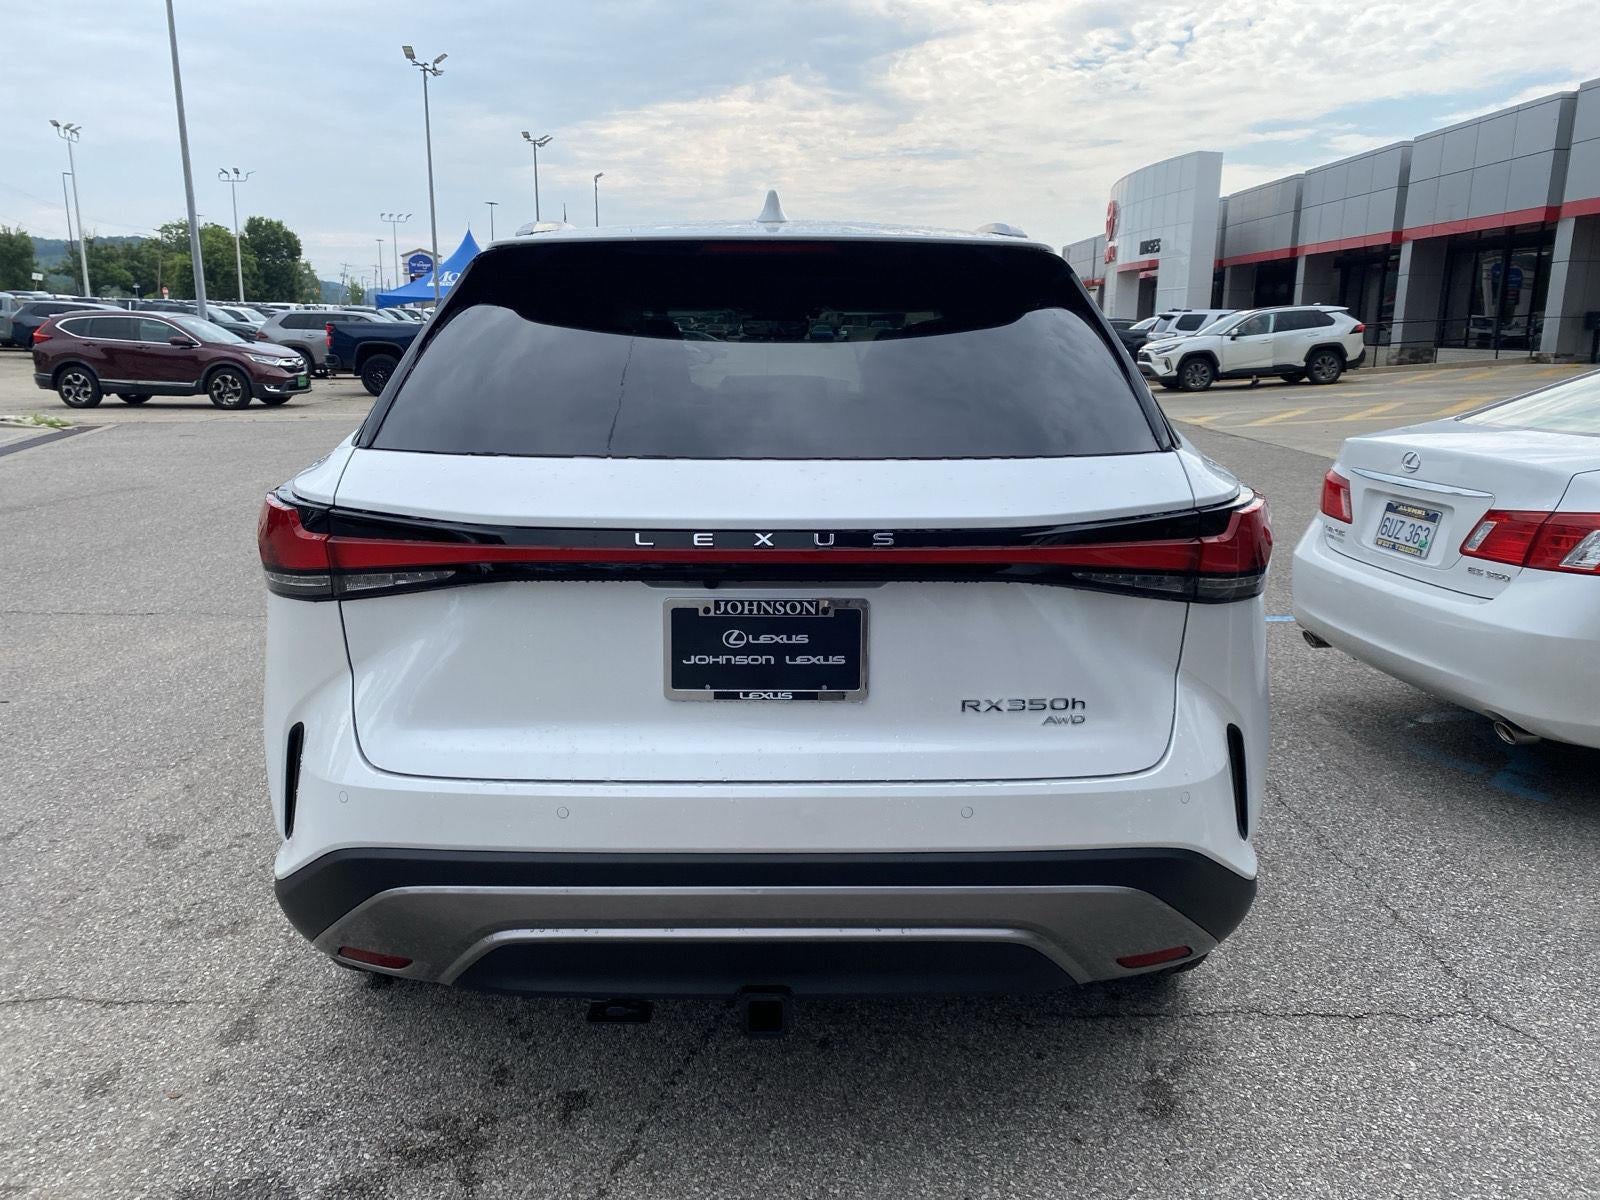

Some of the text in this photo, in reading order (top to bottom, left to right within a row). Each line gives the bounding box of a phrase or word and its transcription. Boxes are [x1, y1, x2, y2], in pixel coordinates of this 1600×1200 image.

[634, 532, 895, 546] LEXUS
[1380, 517, 1431, 548] 6UZ 363
[716, 600, 817, 616] JOHNSON
[748, 634, 809, 644] LEXUS
[682, 655, 846, 665] JOHNSON LEXUS
[739, 692, 793, 700] LEXUS
[1041, 714, 1086, 727] AWD
